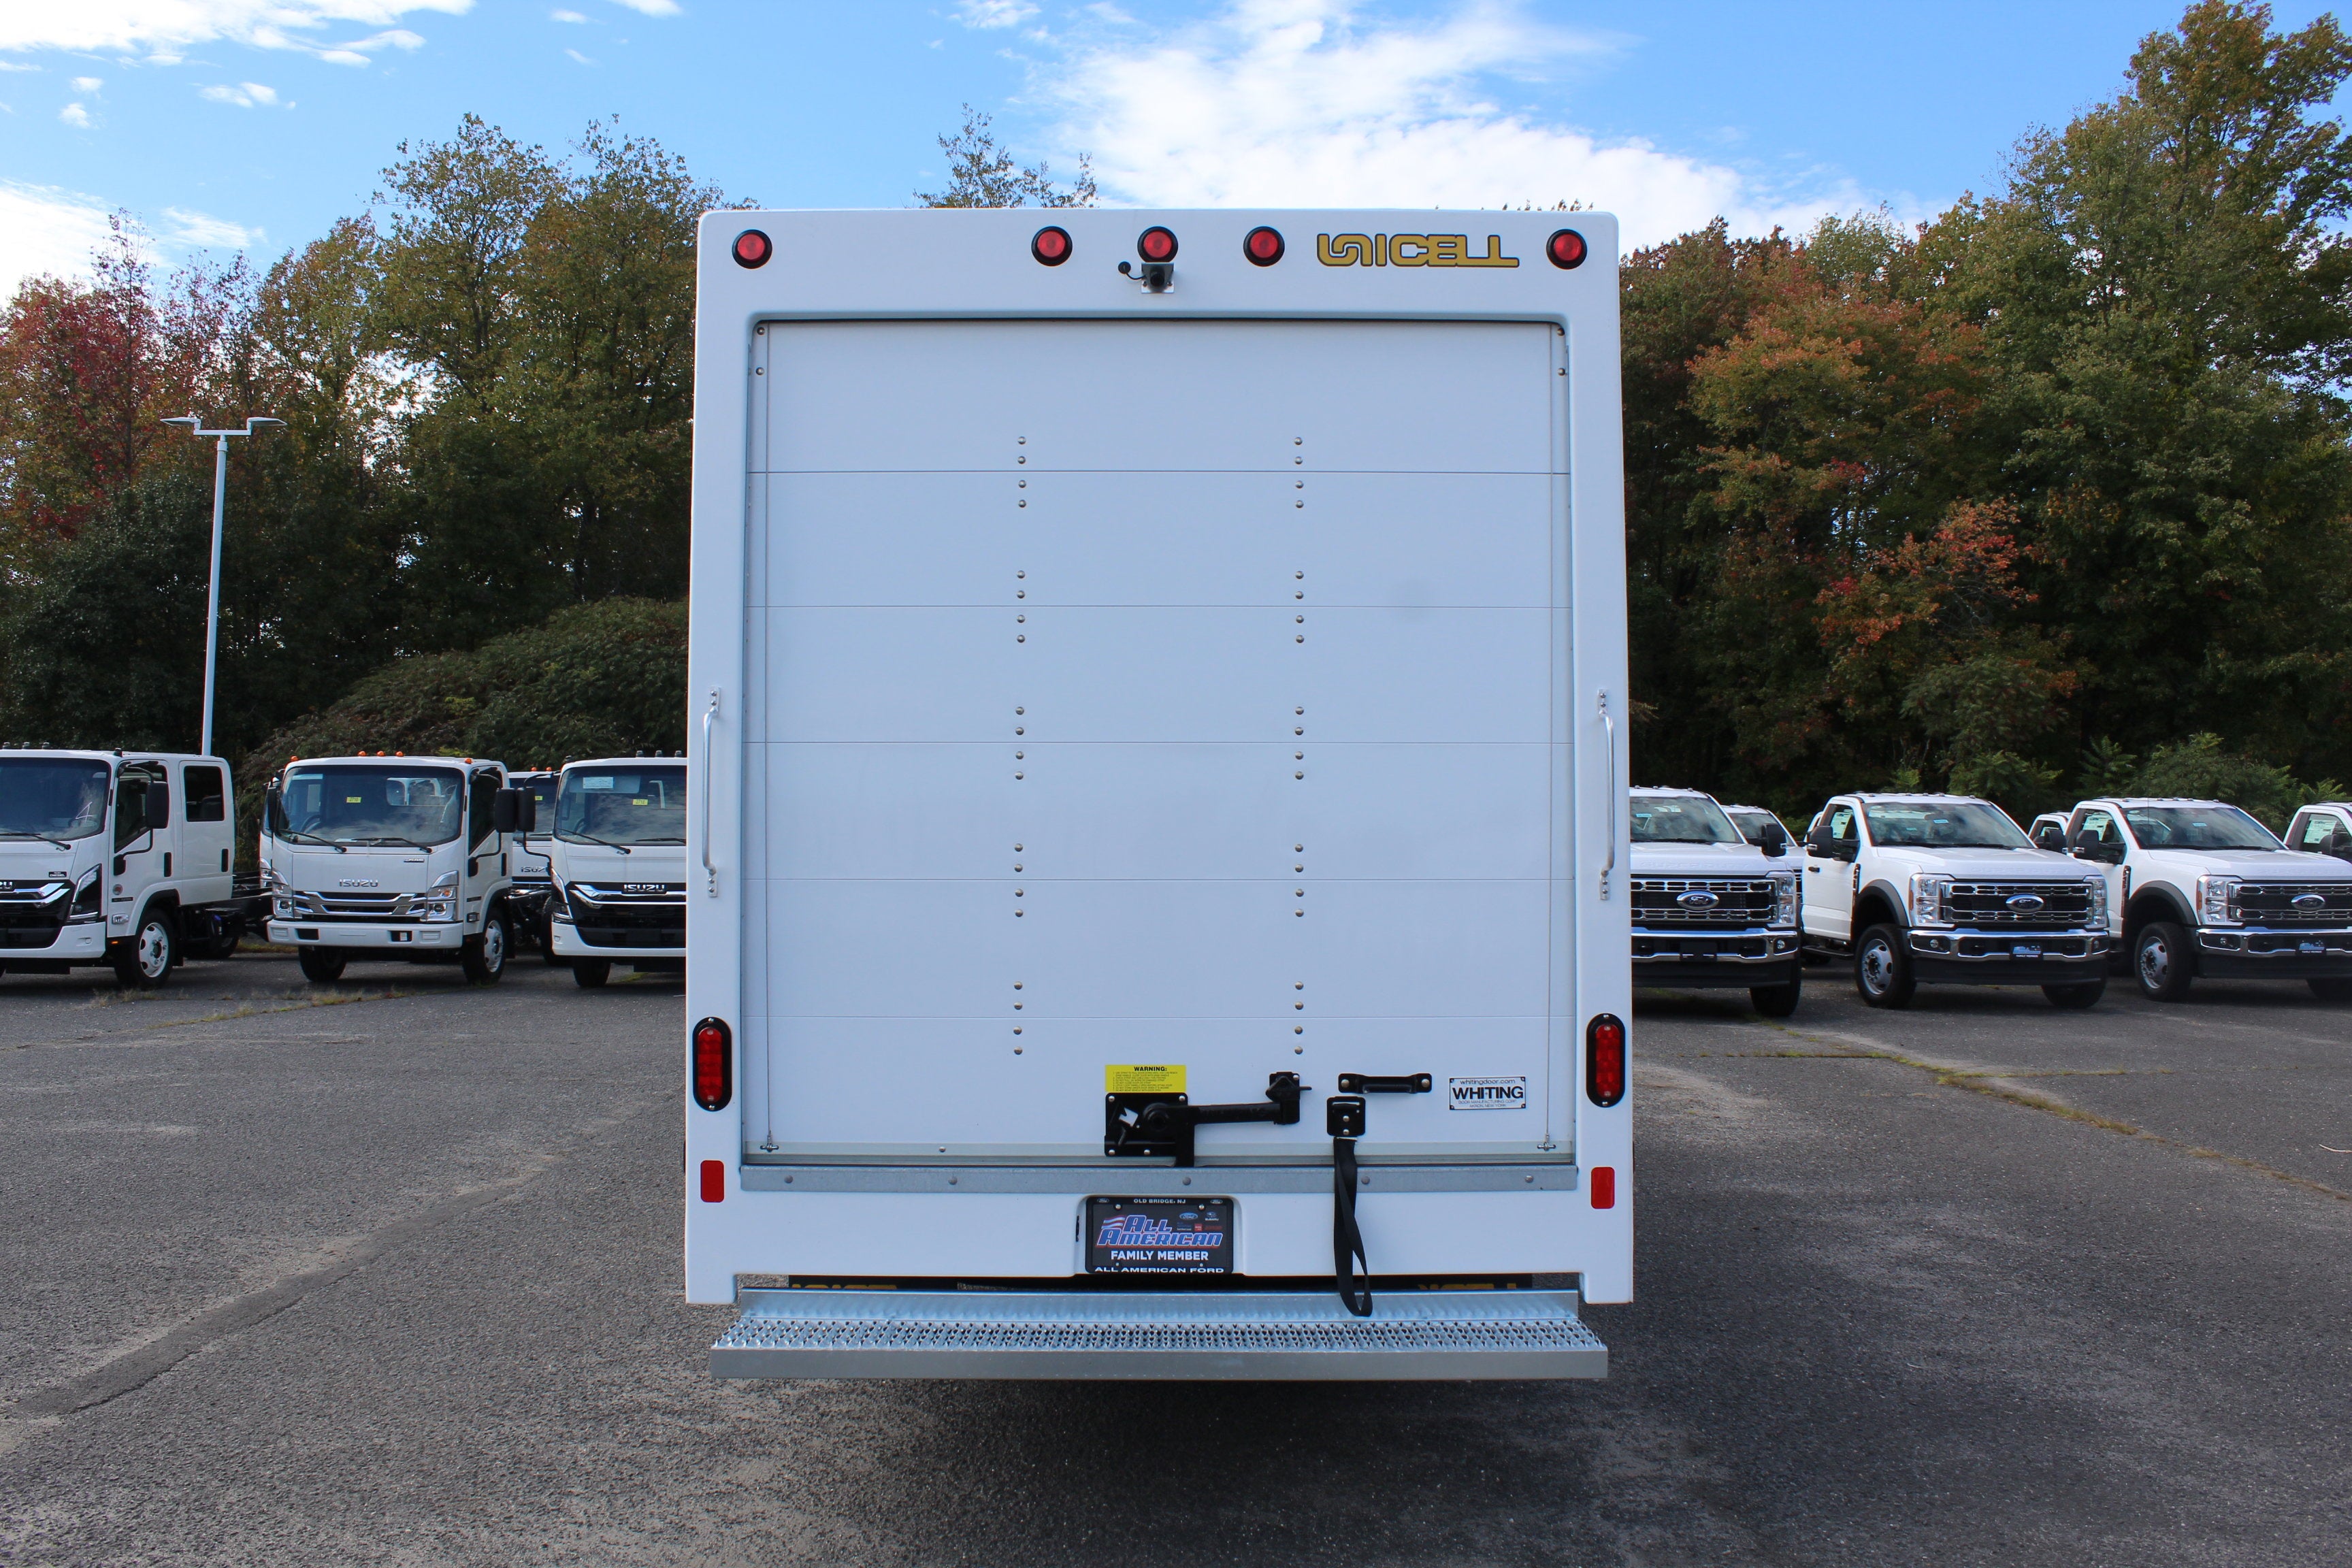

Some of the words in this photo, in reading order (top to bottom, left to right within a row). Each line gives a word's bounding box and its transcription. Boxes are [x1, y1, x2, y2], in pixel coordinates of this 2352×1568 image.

[1316, 233, 1520, 267] UNICELL
[339, 879, 378, 887] ISUZU
[623, 884, 665, 892] ISUZU
[1452, 1085, 1524, 1099] WHITING
[1111, 1251, 1154, 1260] FAMILY
[1158, 1251, 1209, 1260] MEMBER
